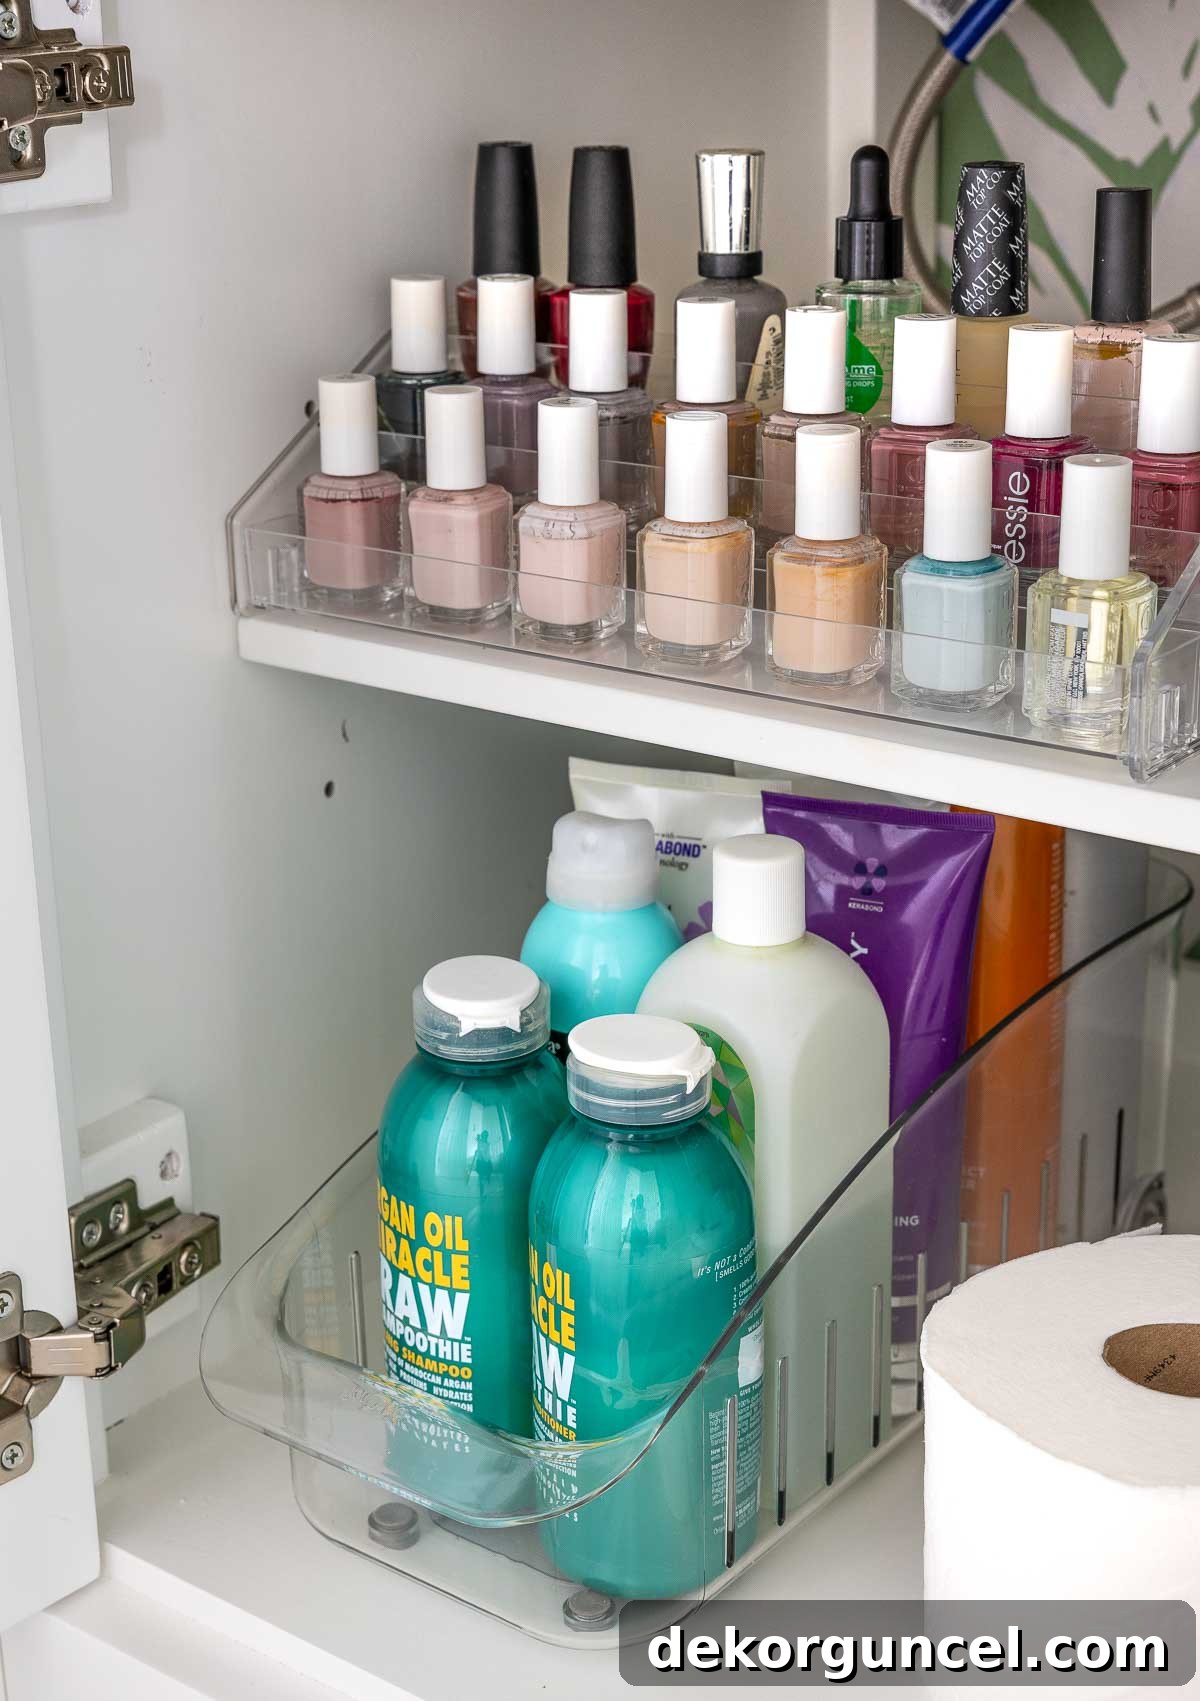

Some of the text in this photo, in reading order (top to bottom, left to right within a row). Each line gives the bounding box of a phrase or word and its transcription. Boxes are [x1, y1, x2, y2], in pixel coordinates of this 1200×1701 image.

[970, 188, 986, 210] TOP
[962, 203, 1005, 256] MATTE
[968, 212, 1011, 263] TOP COAT
[960, 257, 1005, 307] MATTE
[966, 267, 1011, 315] TOP COAT
[1004, 471, 1030, 564] essie
[655, 840, 701, 858] ABOND
[848, 902, 884, 913] KERABOND
[378, 1180, 469, 1251] GAN OIL
[379, 1218, 470, 1290] IRACLE
[697, 1265, 712, 1278] It's
[714, 1255, 732, 1272] NOT
[732, 1253, 738, 1263] a
[380, 1251, 470, 1340] RAW
[542, 1261, 575, 1312] OIL
[401, 1346, 473, 1379] SHAMPOO
[404, 1361, 442, 1385] MOROCCAN
[443, 1377, 473, 1391] ARGAN
[433, 1385, 473, 1402] HYDRATES
[533, 1378, 577, 1430] THIE
